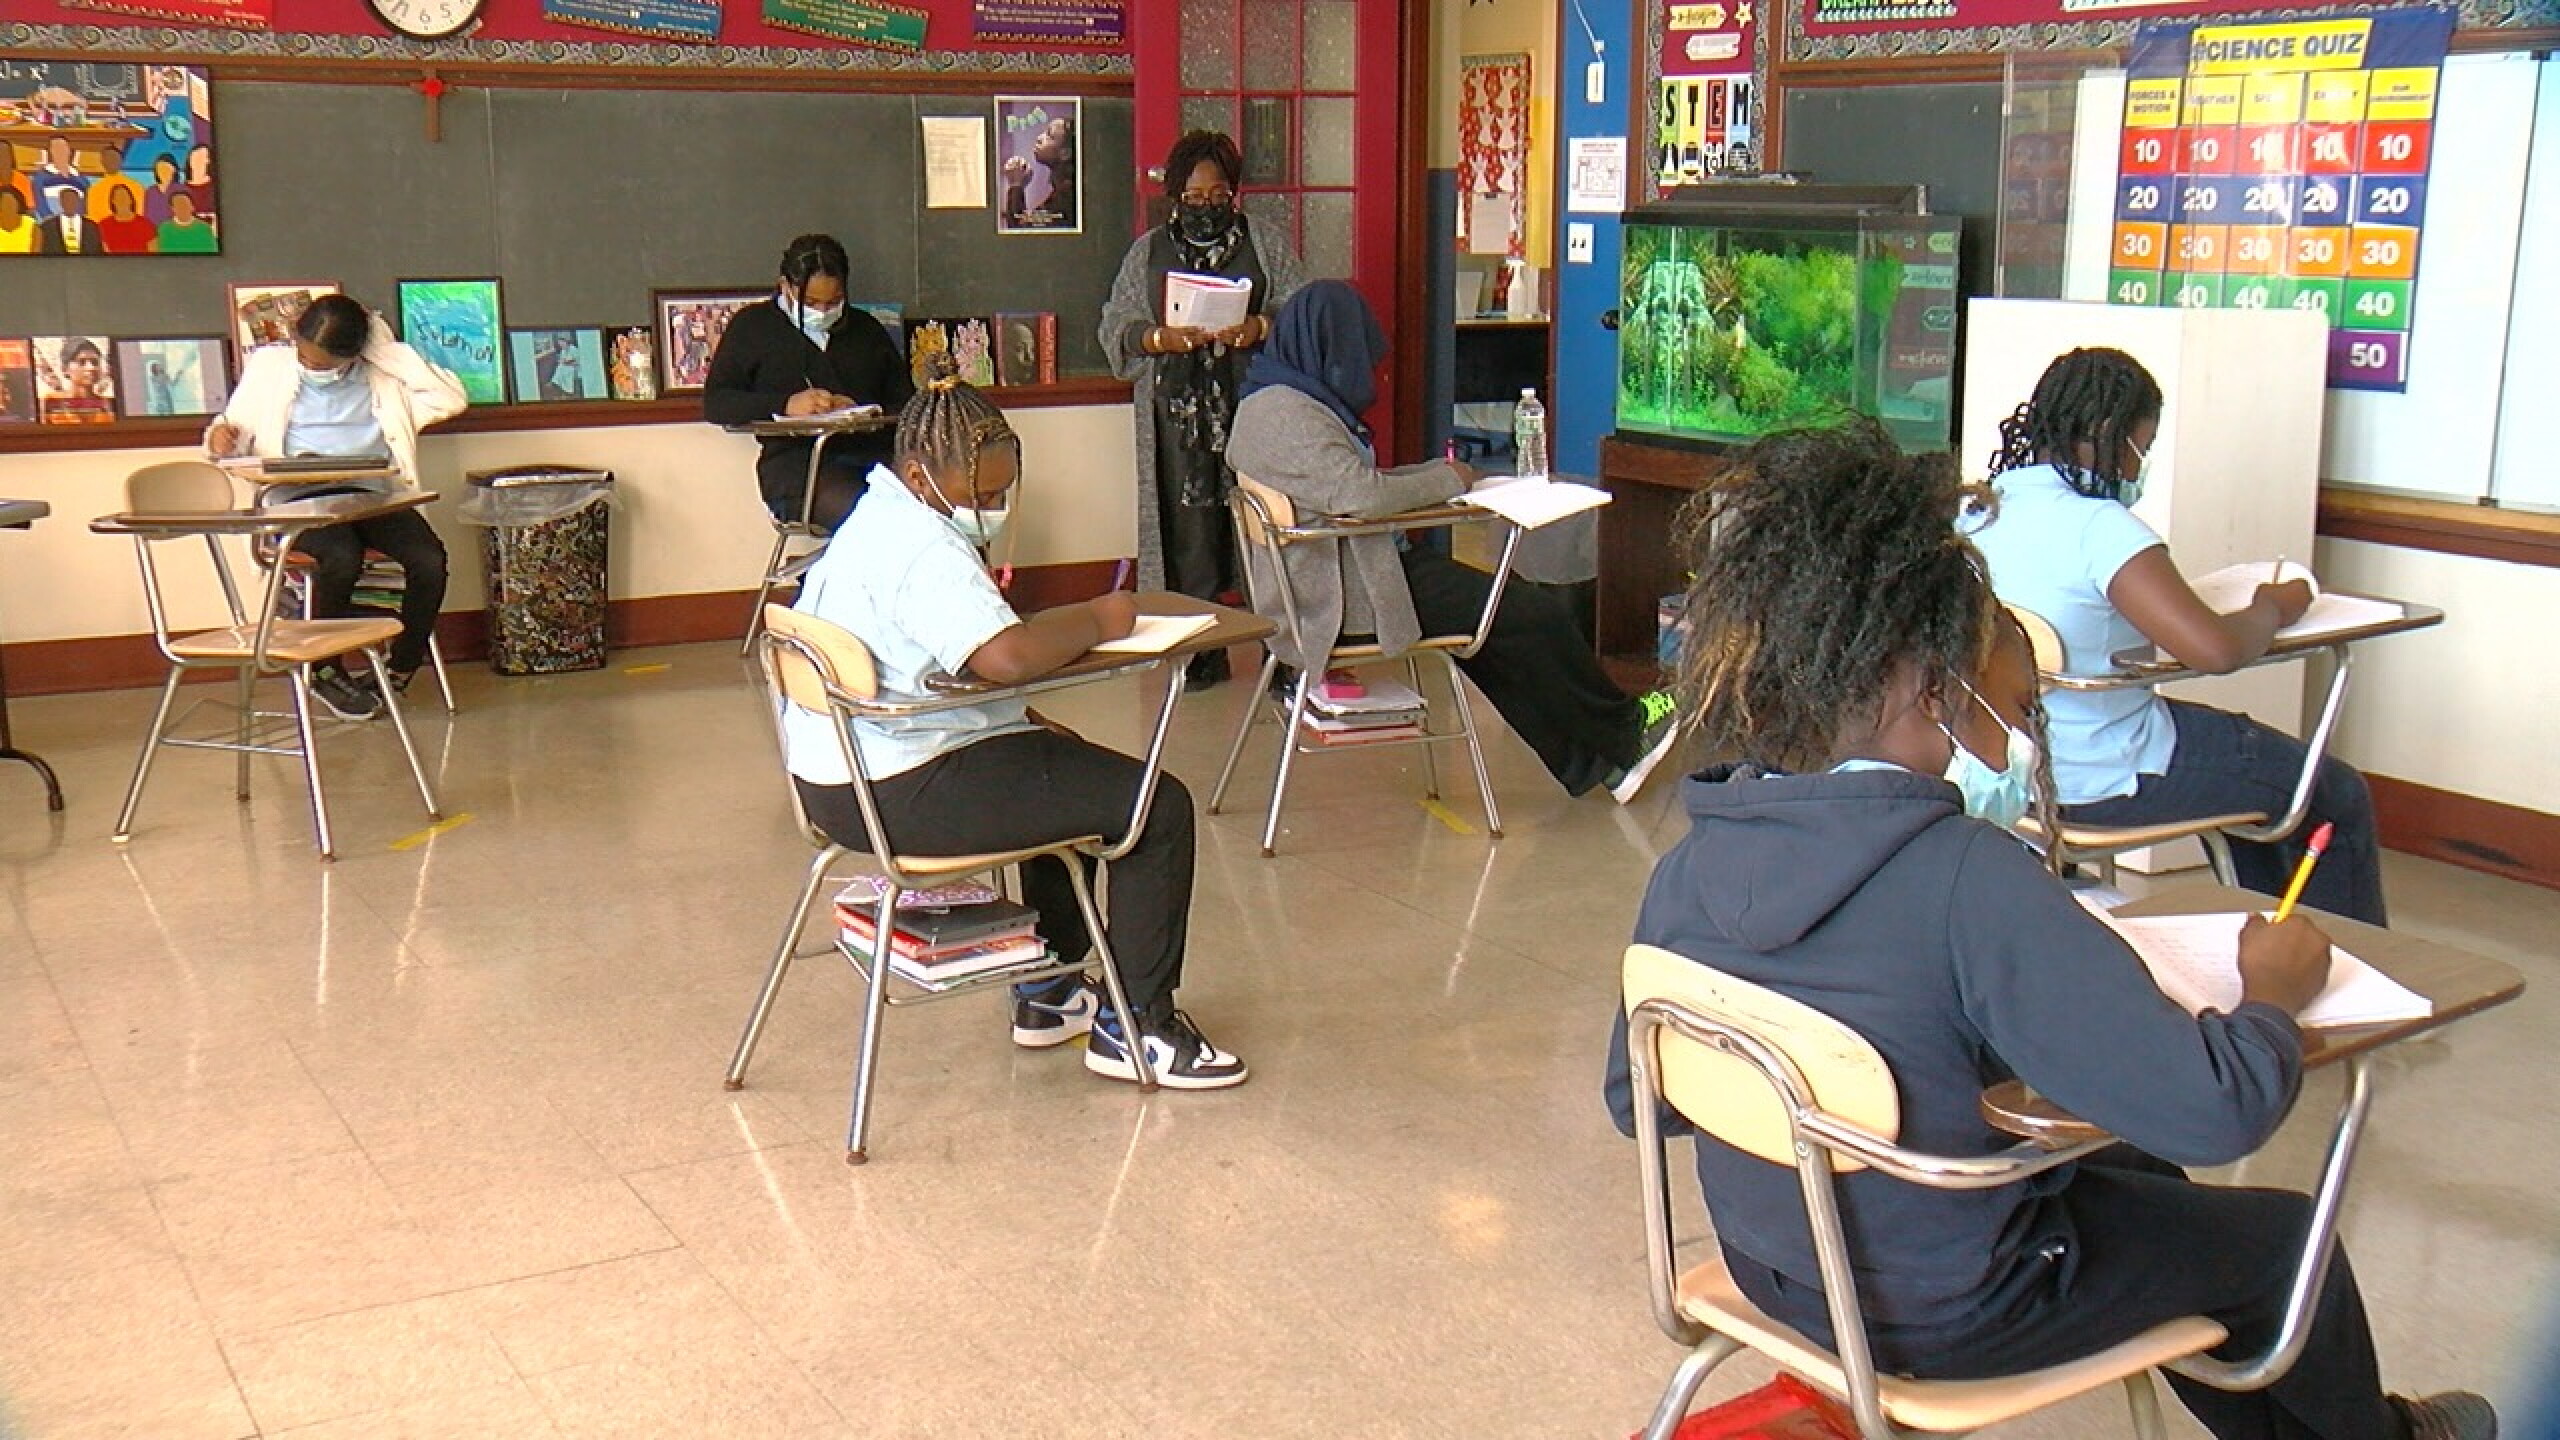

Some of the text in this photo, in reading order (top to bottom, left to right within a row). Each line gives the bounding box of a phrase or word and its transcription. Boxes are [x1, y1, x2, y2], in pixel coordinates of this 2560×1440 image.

[419, 8, 431, 24] 6
[439, 2, 453, 19] 5
[2304, 33, 2365, 57] QUIZ
[1664, 83, 1750, 128] STEM
[2188, 95, 2235, 105] EATHER
[2134, 138, 2161, 163] 10
[2191, 138, 2219, 163] 10
[2250, 136, 2283, 162] 1
[2312, 134, 2344, 160] 10
[2378, 134, 2412, 161] 10
[2128, 186, 2159, 211] 20
[2182, 187, 2218, 211] 20
[2244, 187, 2278, 211] 20
[2303, 185, 2338, 213] 20
[2369, 187, 2409, 214] 20
[2123, 233, 2152, 257] 30
[2180, 236, 2214, 259] 30
[2238, 237, 2272, 260] 30
[2299, 239, 2333, 263] 30
[2361, 240, 2400, 266] 30
[2118, 280, 2147, 303] 40
[2174, 284, 2208, 307] 40
[2234, 285, 2269, 308] 40
[2294, 290, 2328, 309] 40
[2356, 291, 2395, 316] 40
[2350, 343, 2387, 368] 50
